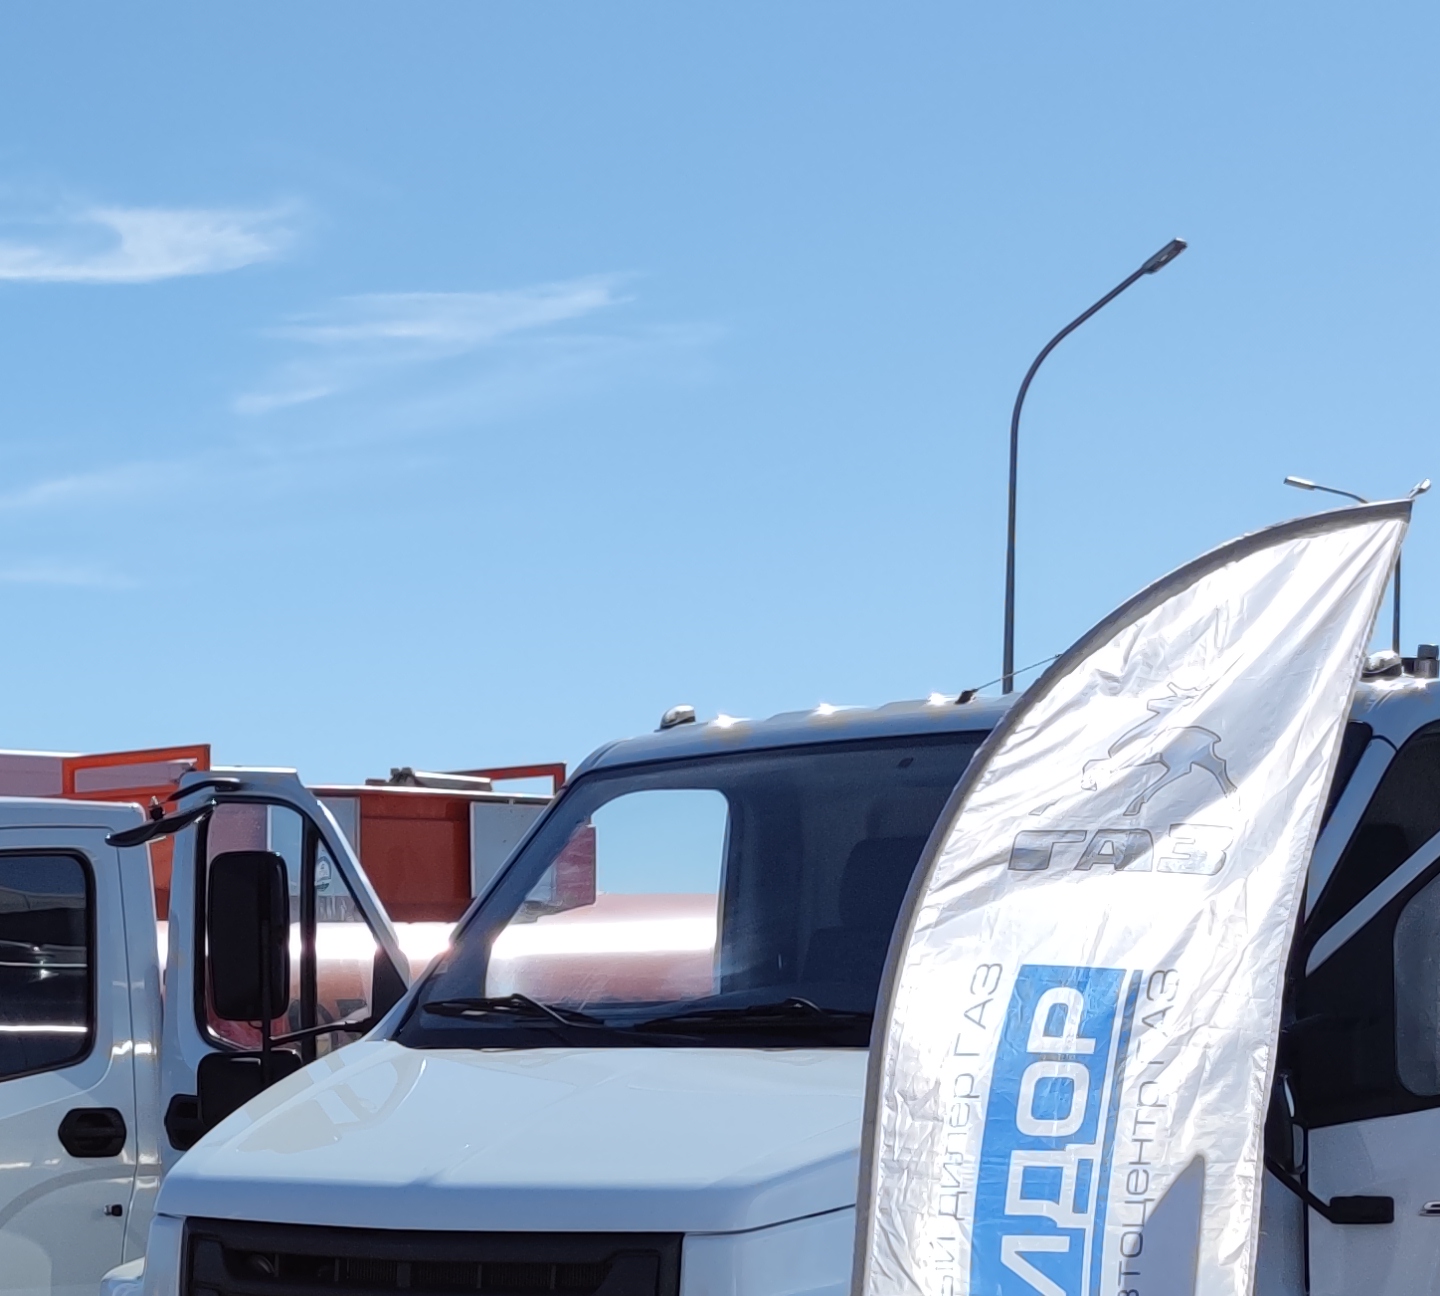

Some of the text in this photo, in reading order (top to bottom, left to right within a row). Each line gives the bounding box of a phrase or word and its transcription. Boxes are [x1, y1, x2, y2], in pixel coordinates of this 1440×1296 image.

[1006, 822, 1237, 877] ГАЗ
[952, 962, 1004, 1057] ГАЗ
[937, 1071, 981, 1221] дилер
